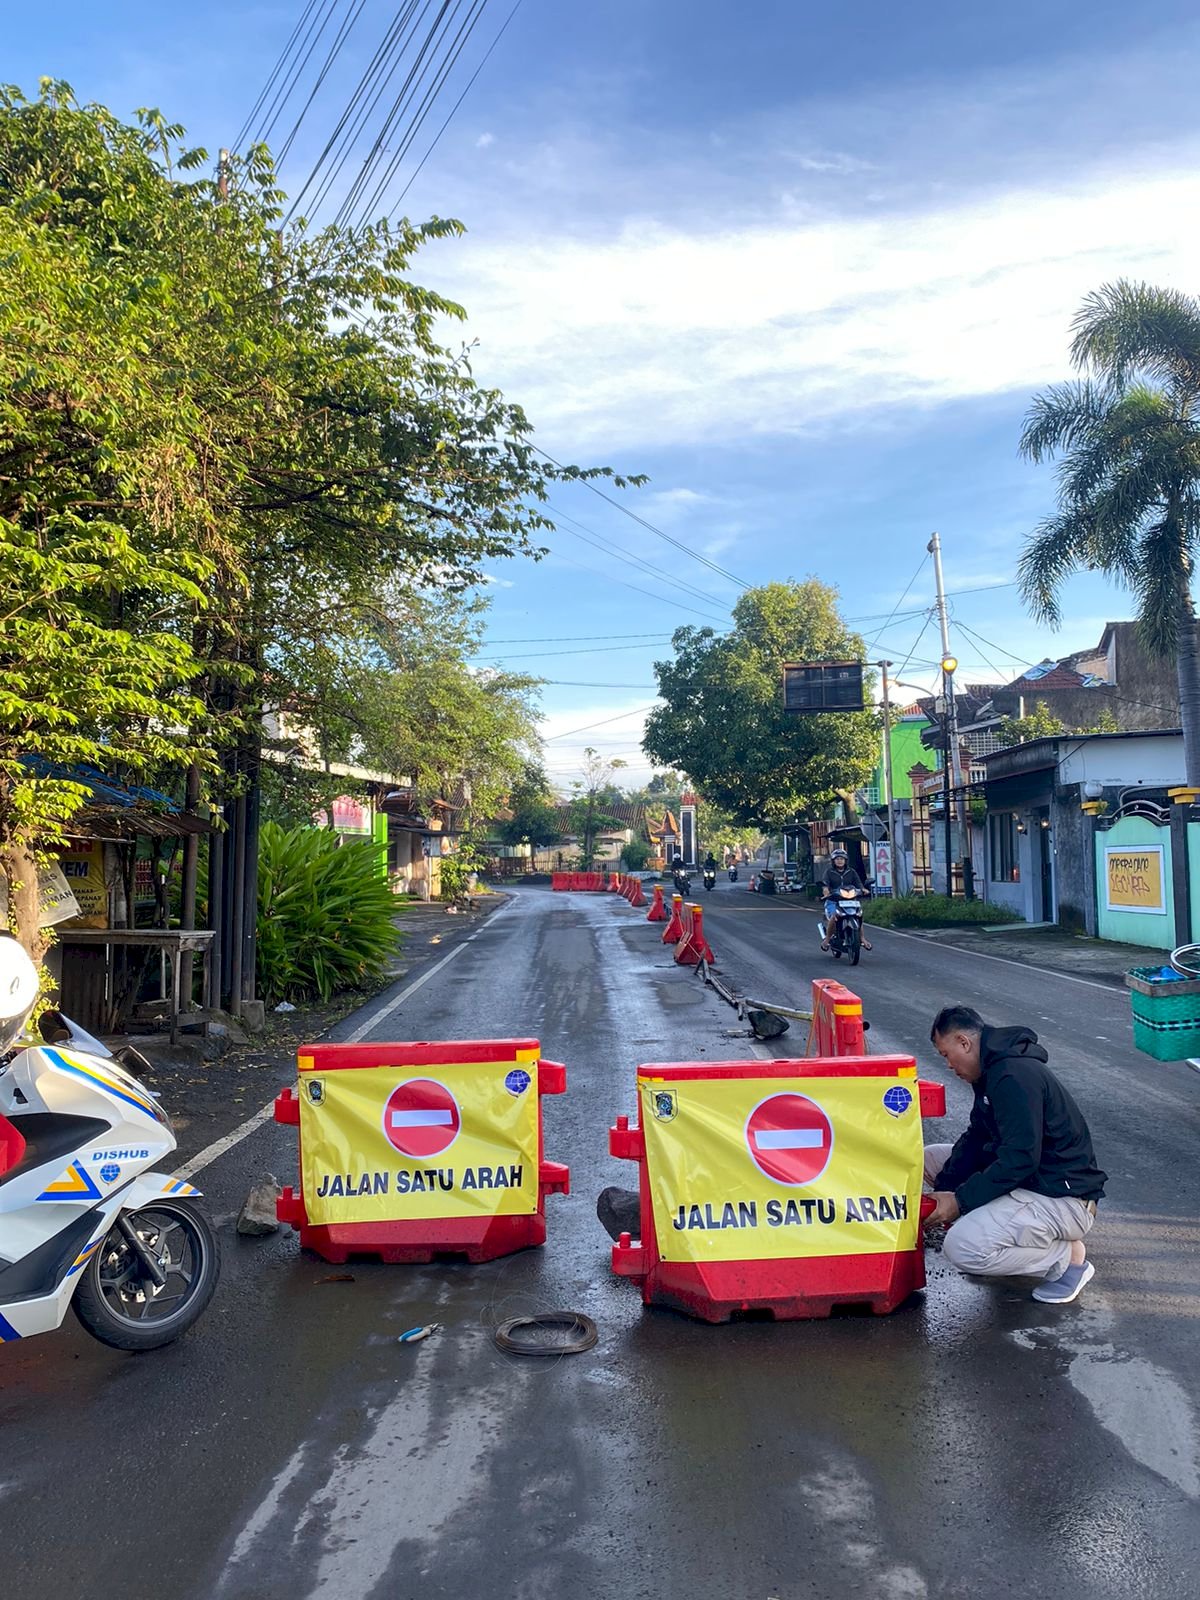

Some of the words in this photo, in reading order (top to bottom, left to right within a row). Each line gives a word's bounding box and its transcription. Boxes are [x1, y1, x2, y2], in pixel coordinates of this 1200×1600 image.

[92, 1150, 149, 1161] DISHUB
[316, 1171, 389, 1198] JALAN
[396, 1168, 454, 1194] SATU
[461, 1165, 524, 1190] ARAH
[672, 1201, 758, 1231] JALAN
[765, 1198, 836, 1228] SATU
[844, 1194, 908, 1223] ARAH
